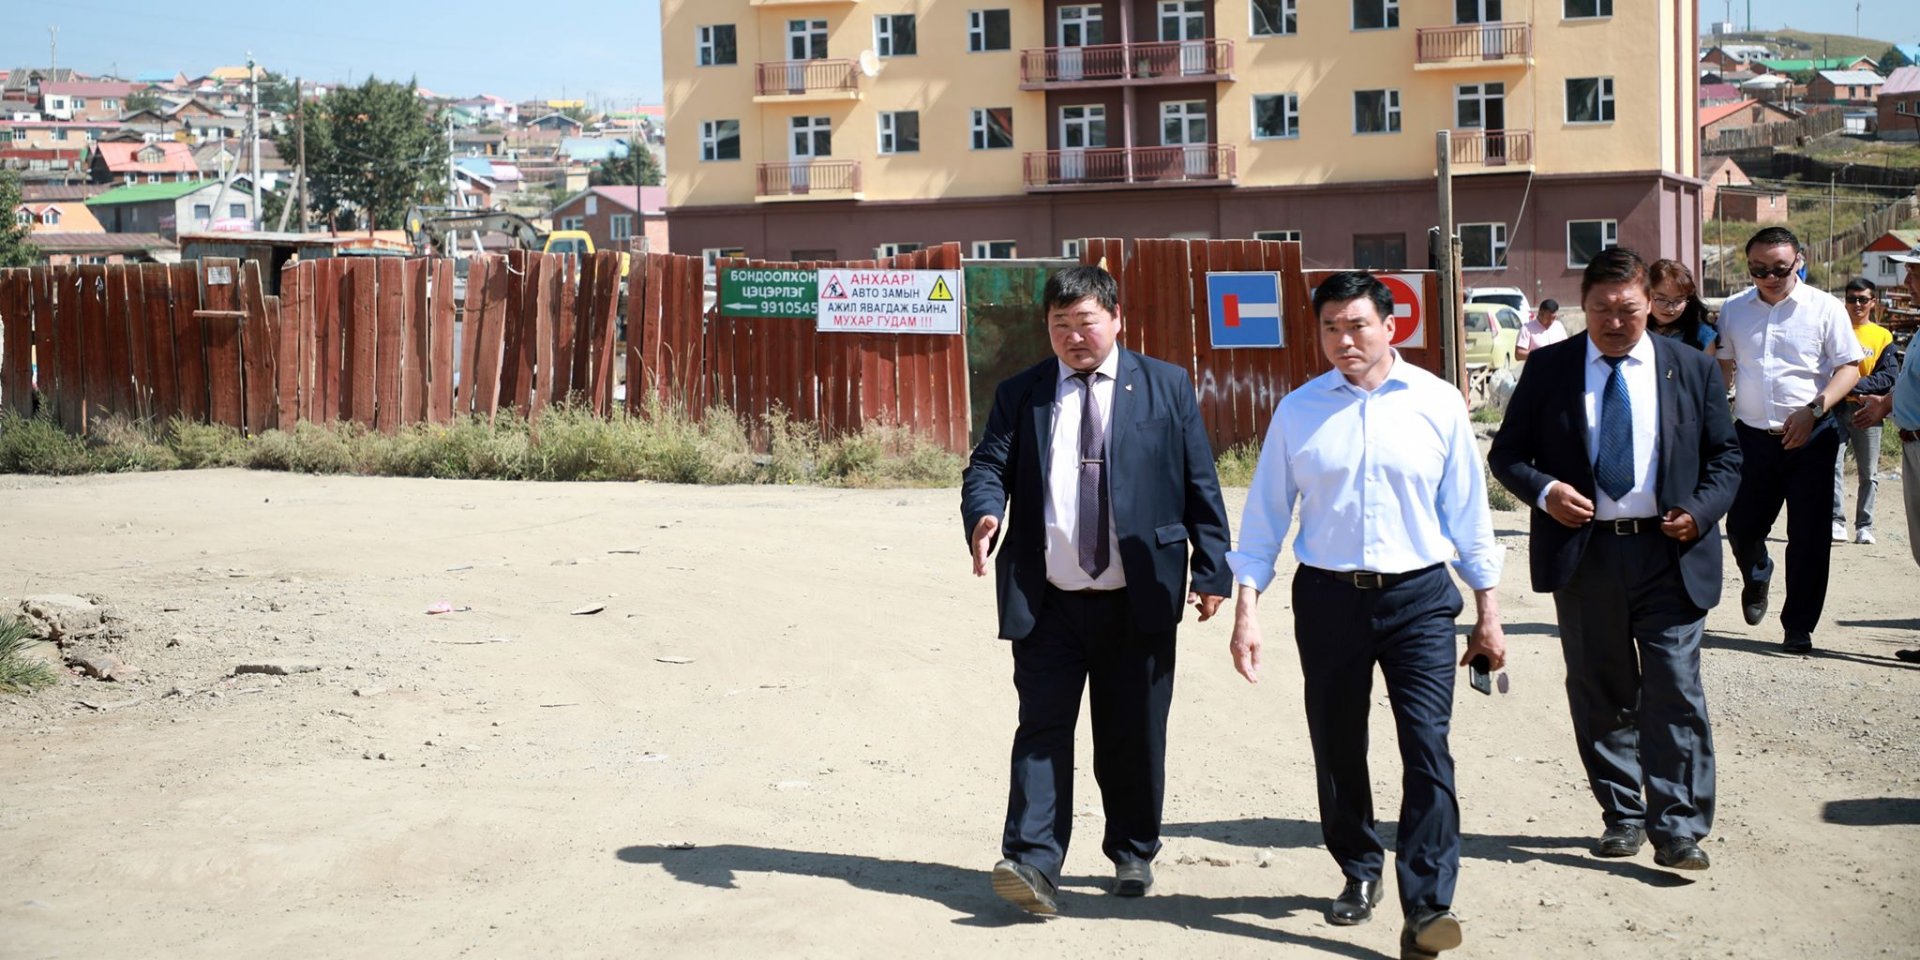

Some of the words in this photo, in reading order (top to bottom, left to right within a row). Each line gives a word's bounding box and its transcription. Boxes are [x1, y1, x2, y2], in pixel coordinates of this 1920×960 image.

[450, 220, 483, 228] VOLVO
[731, 270, 817, 283] БОНДООЛХОН
[850, 273, 915, 285] АНХААР!
[742, 286, 806, 299] ЦЭЦЭРЛЭГ
[851, 288, 879, 298] АВТО
[882, 288, 920, 299] ЗАМЫН
[761, 301, 818, 314] 9910545
[827, 302, 857, 312] АЖИЛ
[860, 303, 909, 314] ЯВАГДАЖ
[912, 302, 948, 314] БАЙНА
[833, 315, 873, 327] МУХАР
[877, 316, 917, 328] ГУДАМ
[921, 316, 932, 327] !!!
